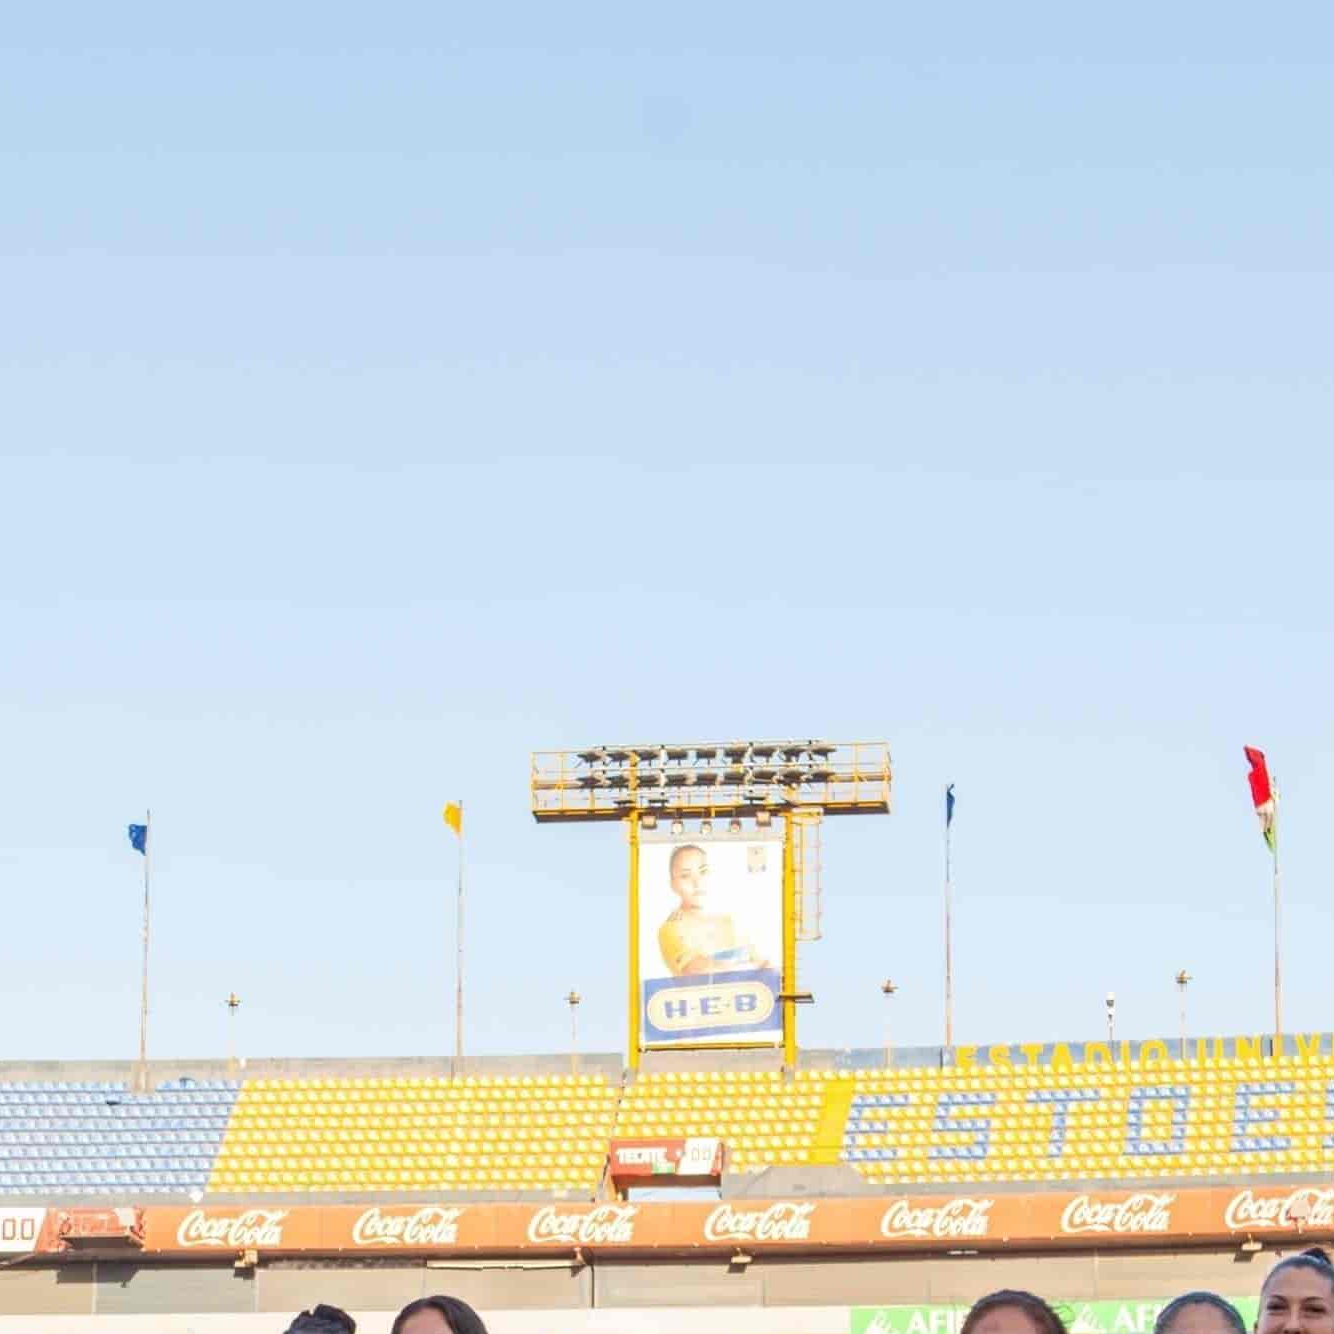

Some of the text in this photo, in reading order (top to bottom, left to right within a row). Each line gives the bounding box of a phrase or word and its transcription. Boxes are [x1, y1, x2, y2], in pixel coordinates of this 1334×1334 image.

[955, 1040, 1169, 1070] ESTADIO
[177, 1208, 291, 1247] Coca-Cola
[352, 1206, 465, 1245] Coca-Cola
[527, 1205, 640, 1245] Coca-Cola
[704, 1202, 816, 1241] Coca-Cola
[880, 1198, 994, 1238] Coca-Cola
[1060, 1193, 1177, 1235] Coca-Cola
